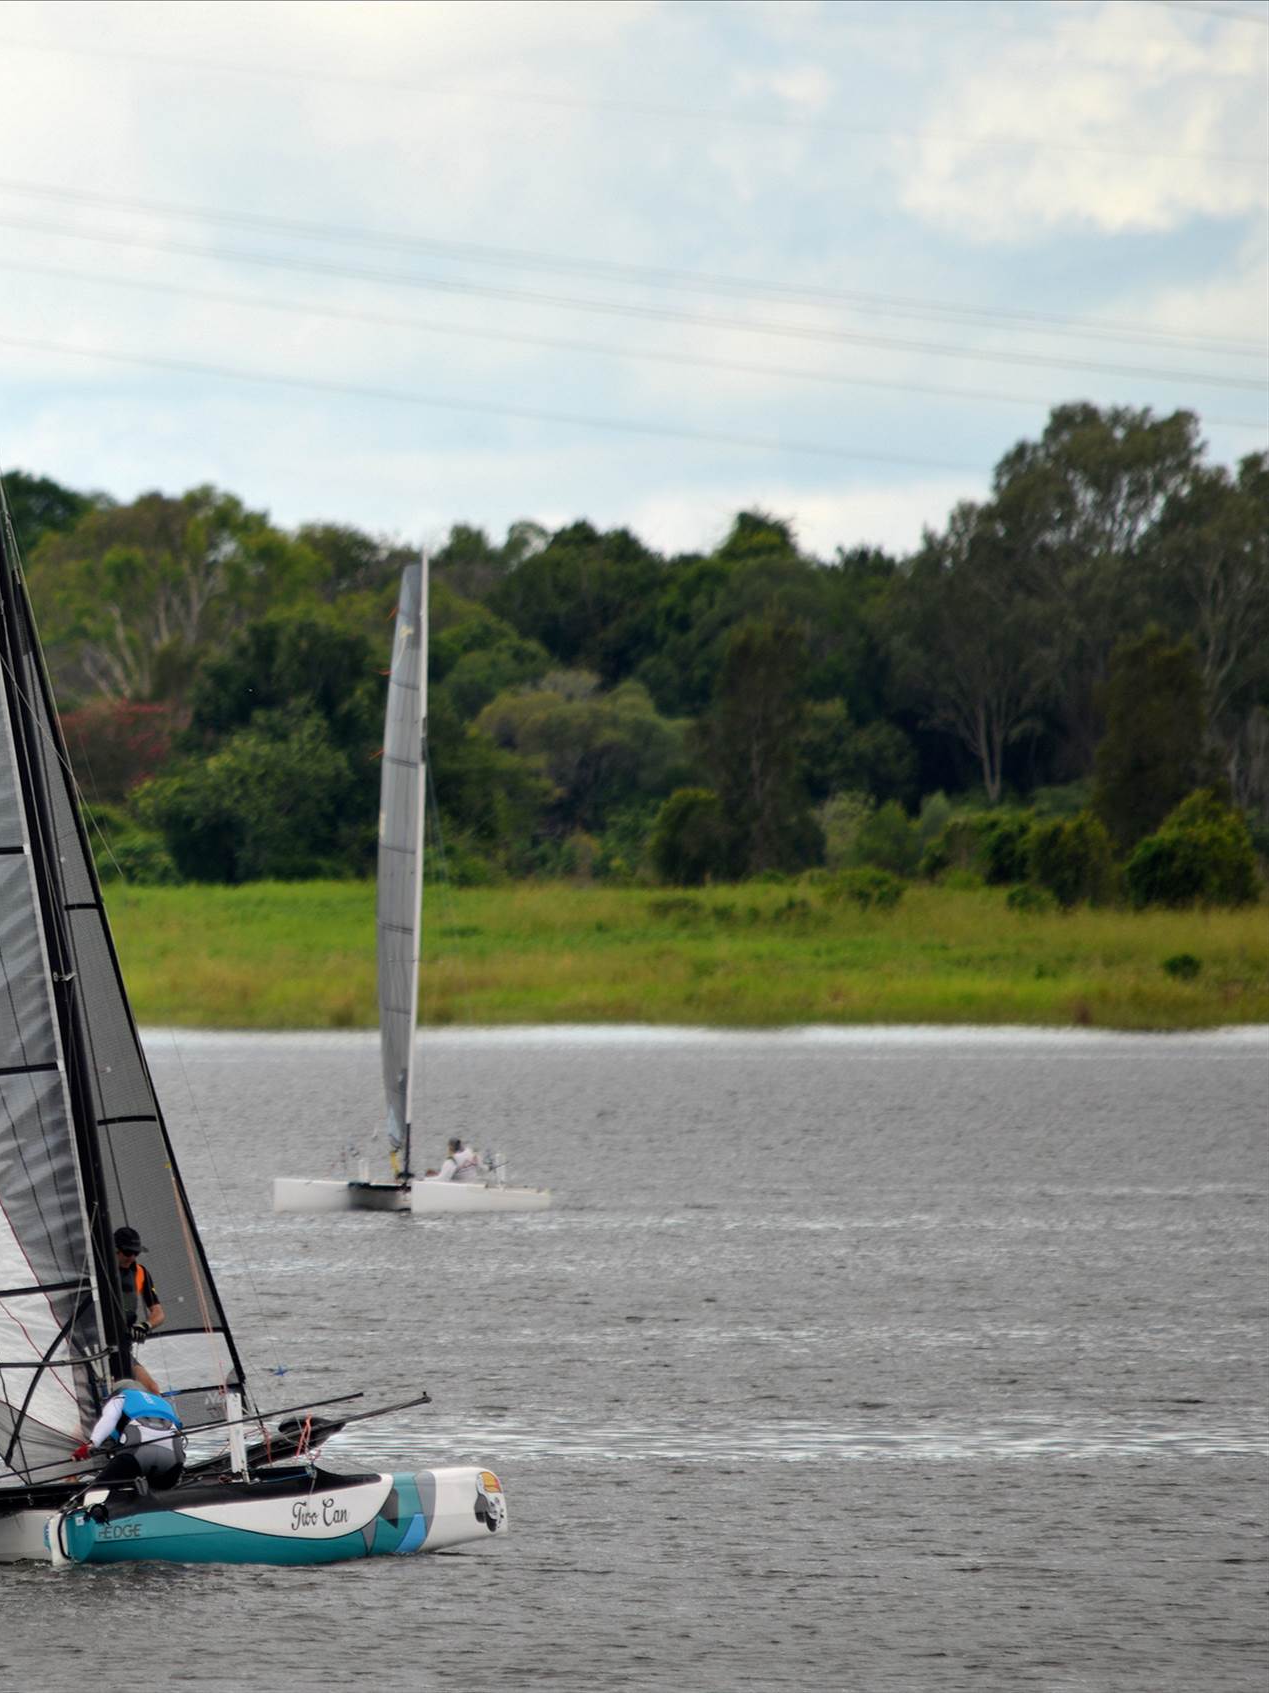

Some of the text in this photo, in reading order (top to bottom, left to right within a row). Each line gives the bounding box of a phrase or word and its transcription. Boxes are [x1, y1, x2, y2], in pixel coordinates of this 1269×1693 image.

[291, 1498, 348, 1531] Two Can
[102, 1524, 142, 1539] EDGE
